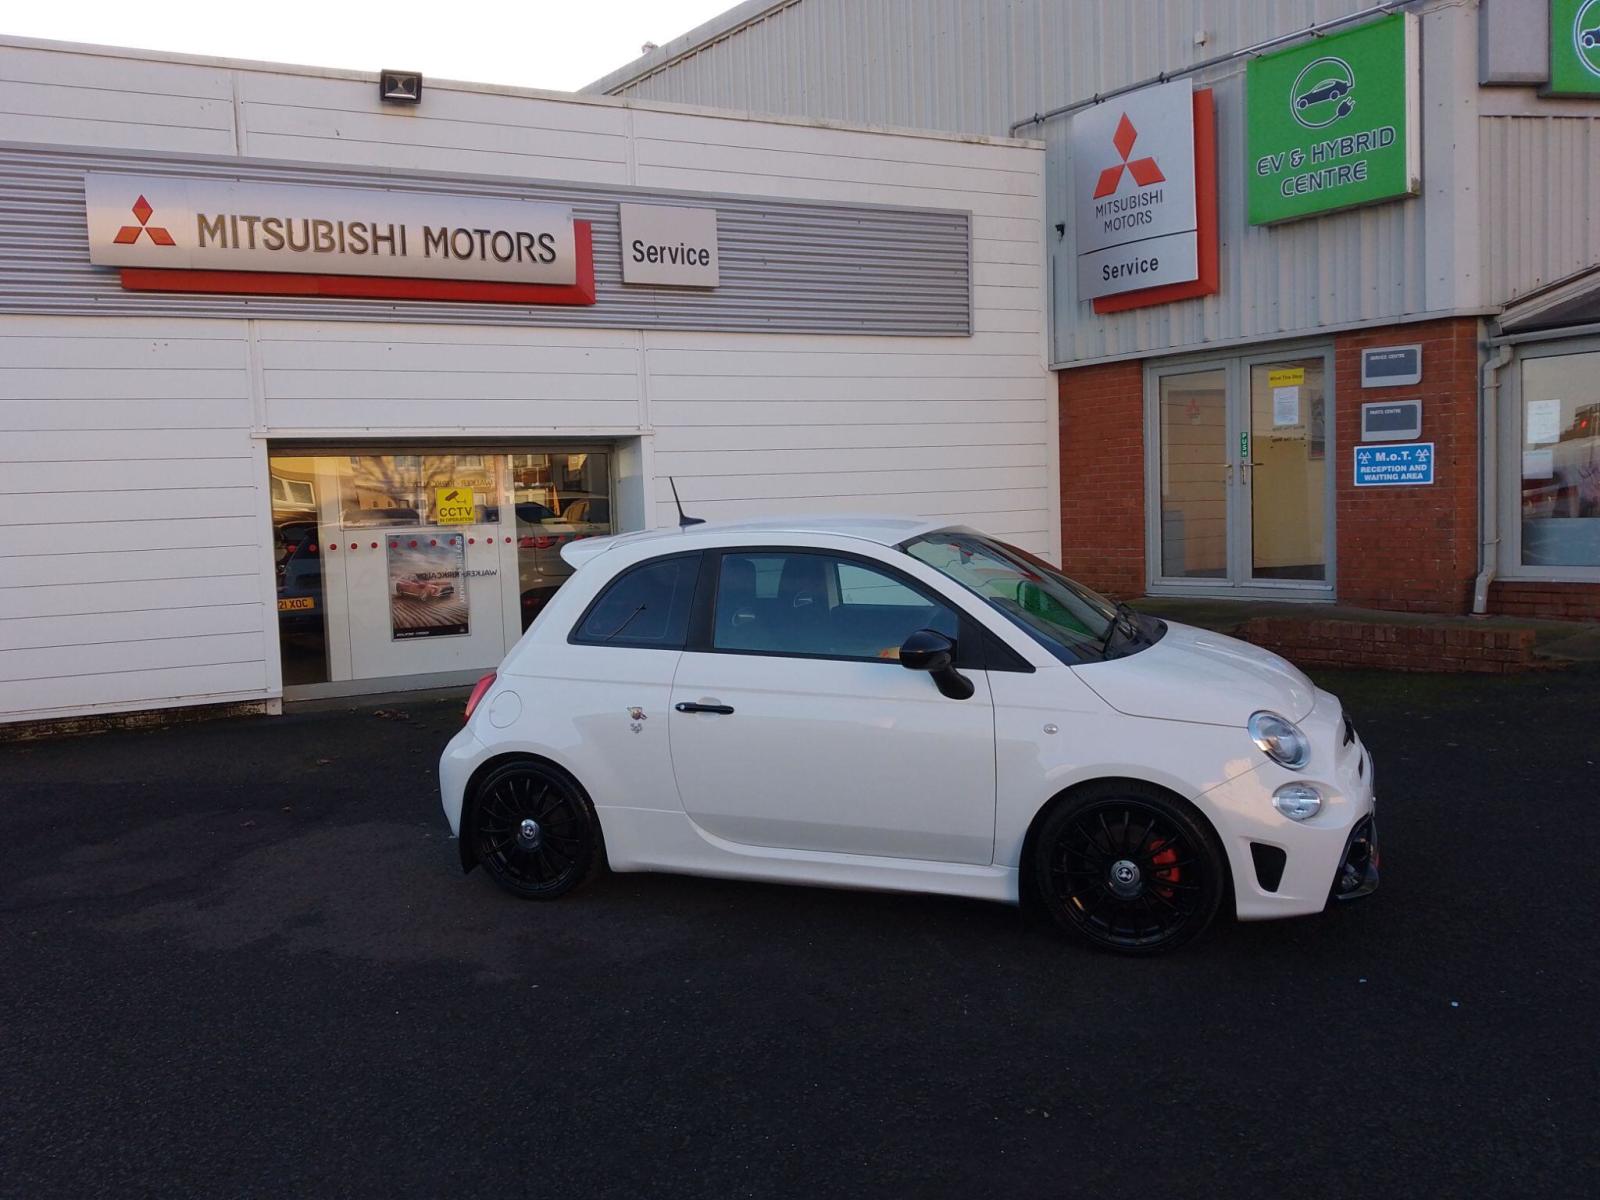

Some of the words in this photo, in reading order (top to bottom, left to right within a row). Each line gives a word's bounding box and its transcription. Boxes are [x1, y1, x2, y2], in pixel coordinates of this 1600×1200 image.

[1257, 152, 1285, 177] EV
[1290, 149, 1305, 169] &
[1311, 126, 1396, 165] HYBRID
[1280, 160, 1367, 199] CENTRE
[1095, 189, 1163, 218] MITSUBISHI
[1104, 210, 1152, 233] MOTORS
[196, 213, 407, 257] MITSUBISHI
[423, 225, 557, 264] MOTORS
[632, 239, 710, 267] Service
[1102, 256, 1159, 281] Service
[1360, 464, 1407, 473] RECEPTION
[1364, 473, 1399, 481] WAITING
[1400, 472, 1424, 480] AREA
[439, 506, 473, 517] CCTV
